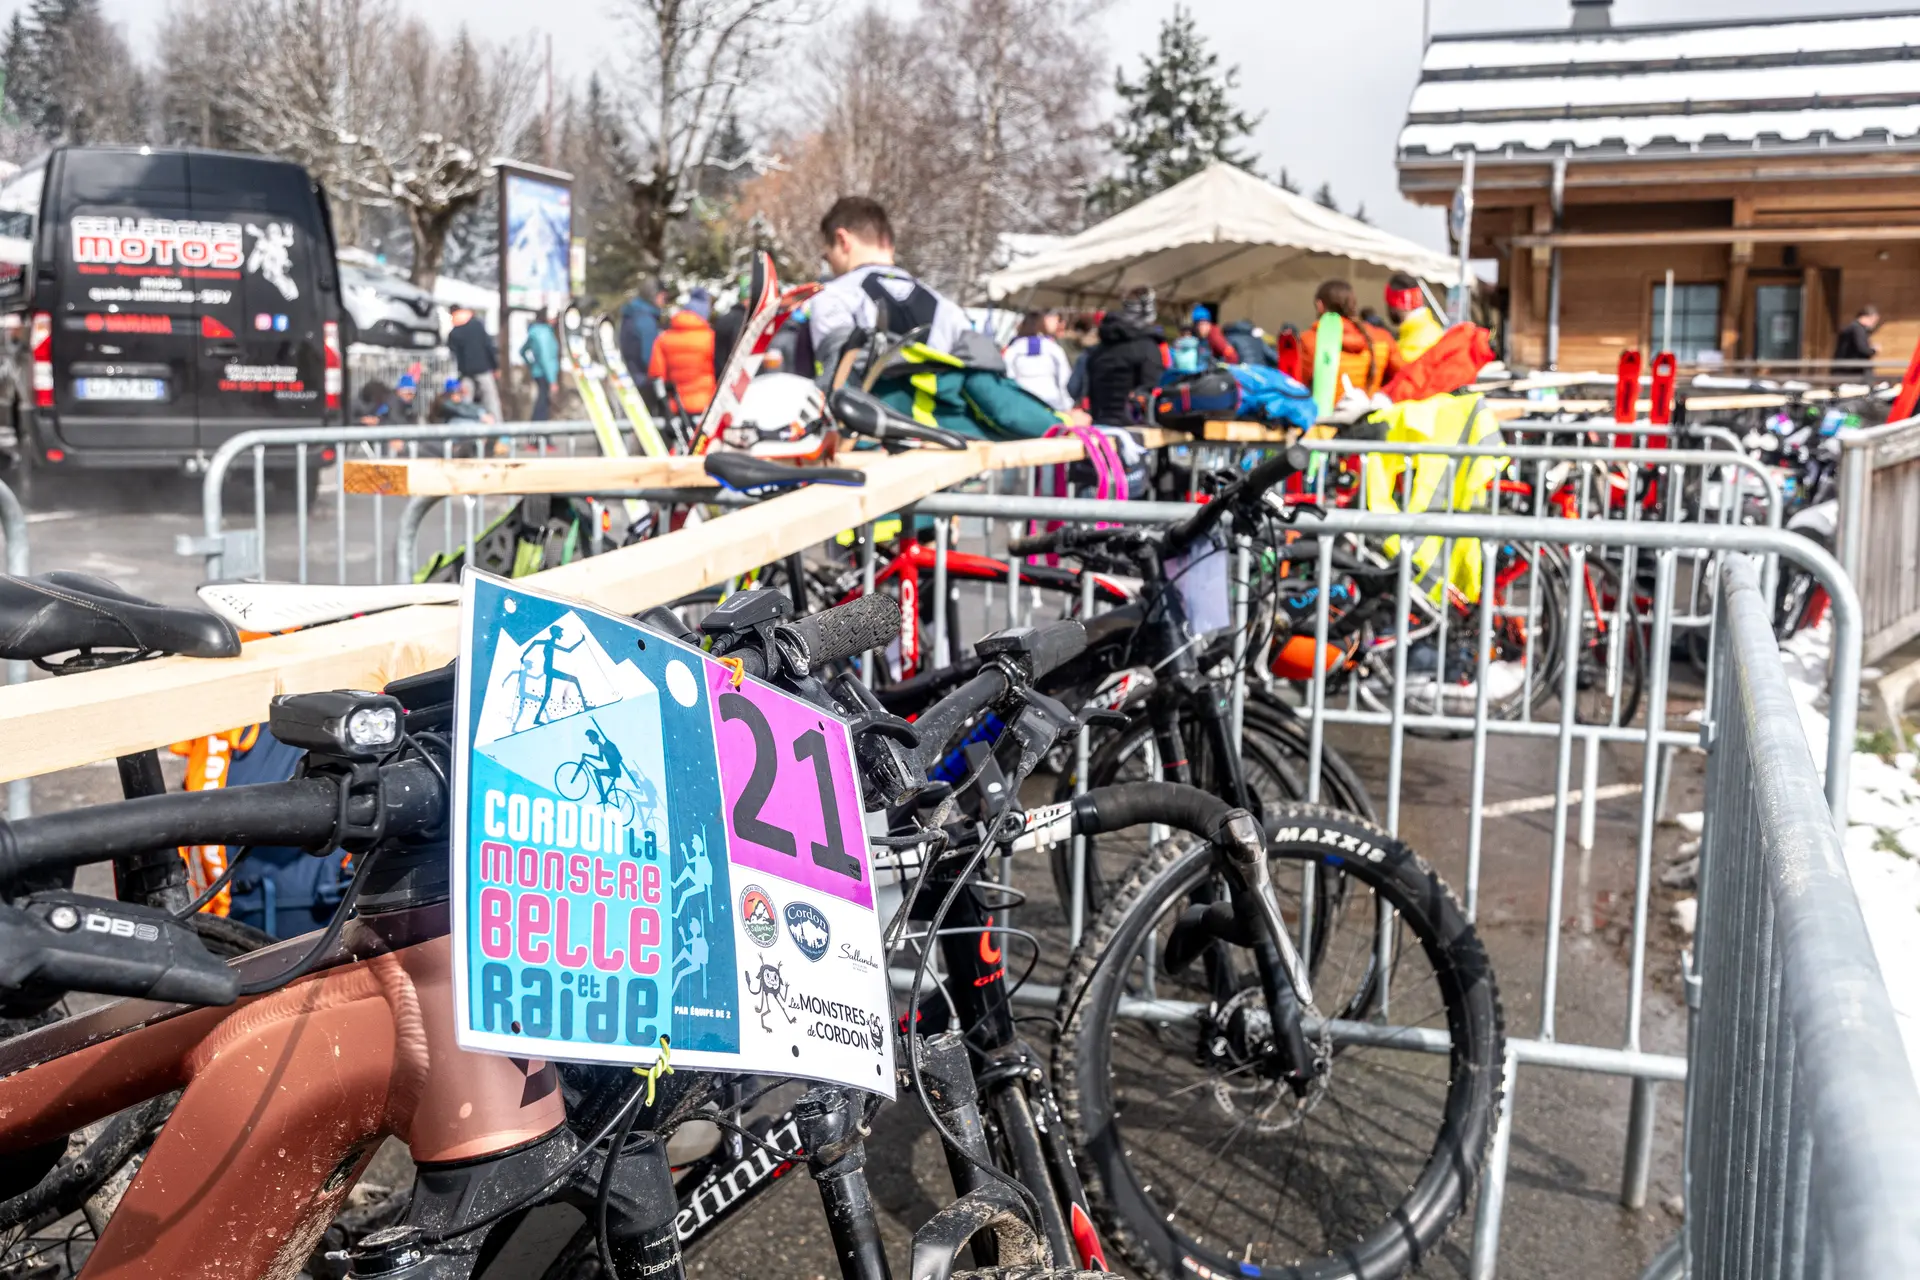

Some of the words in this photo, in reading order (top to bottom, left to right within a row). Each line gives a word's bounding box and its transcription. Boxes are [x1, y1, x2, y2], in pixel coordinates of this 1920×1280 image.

[79, 236, 238, 264] MOTOS
[718, 692, 862, 882] 21
[484, 789, 624, 856] CORDON
[1274, 826, 1387, 863] MAXXIS
[86, 913, 159, 942] DB8
[787, 905, 826, 931] Cordon
[837, 943, 879, 969] Sallanches
[674, 1005, 689, 1015] PAR
[690, 1005, 714, 1018] ÉQUIPE
[715, 1009, 725, 1019] DE
[725, 1010, 731, 1019] 2
[788, 996, 800, 1010] Les
[799, 992, 866, 1027] MONSTRES
[807, 1024, 817, 1038] de
[815, 1021, 870, 1051] CORDON
